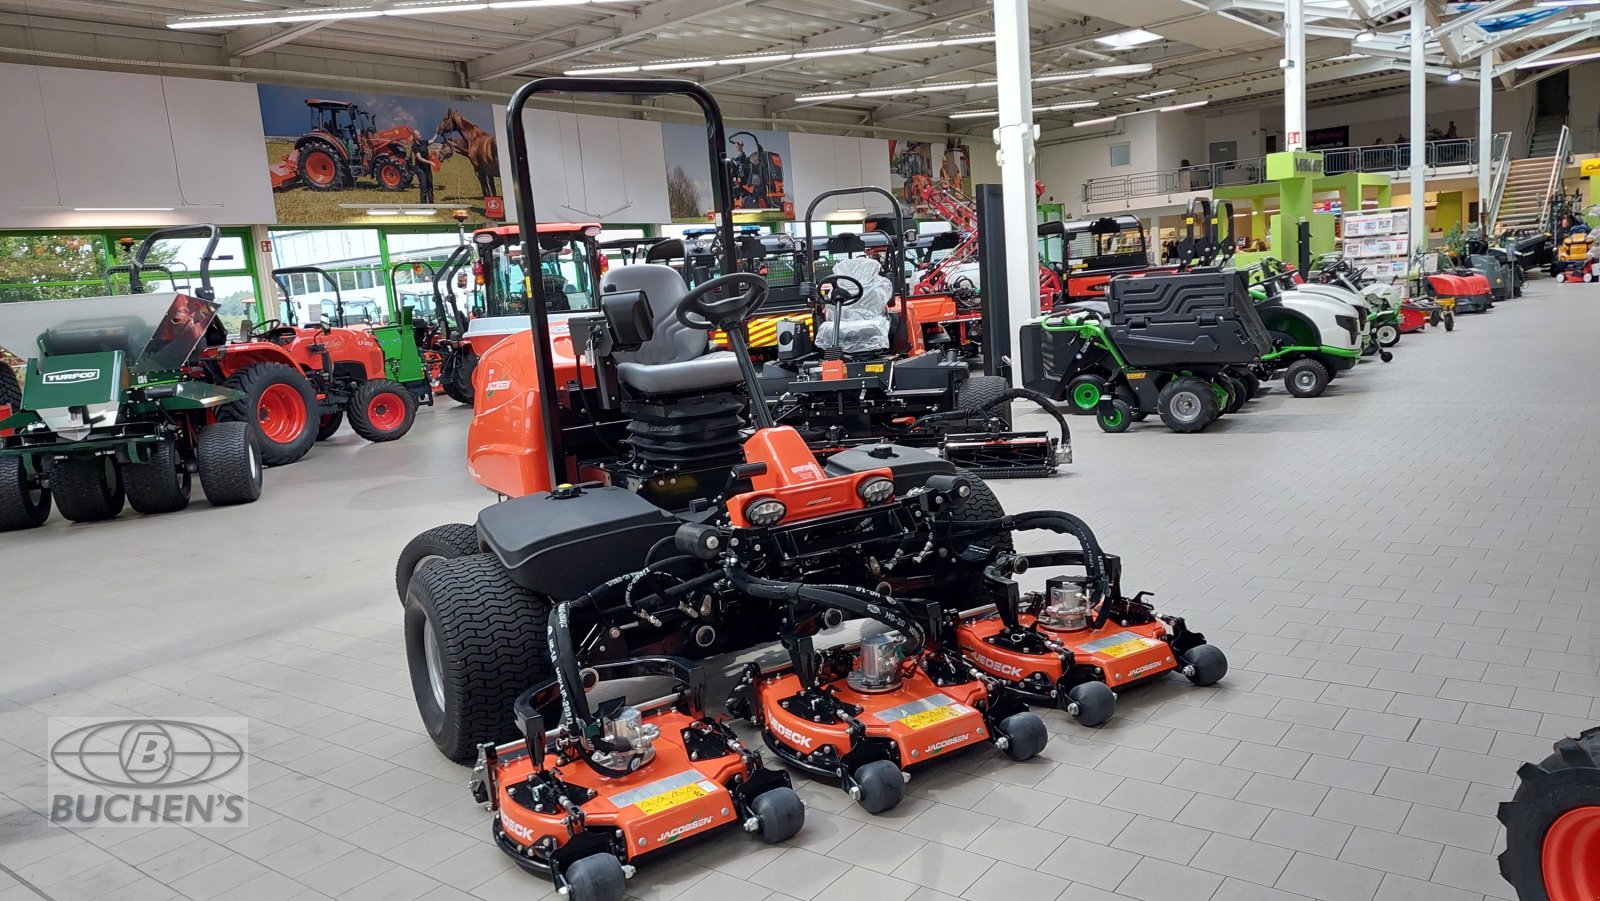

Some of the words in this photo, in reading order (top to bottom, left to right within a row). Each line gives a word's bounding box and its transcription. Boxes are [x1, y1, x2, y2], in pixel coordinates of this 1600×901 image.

[48, 371, 96, 381] TURFCO
[1127, 661, 1163, 676] JACOBSEN
[925, 733, 970, 753] JACOBSEN
[656, 815, 713, 842] JACOBSEN
